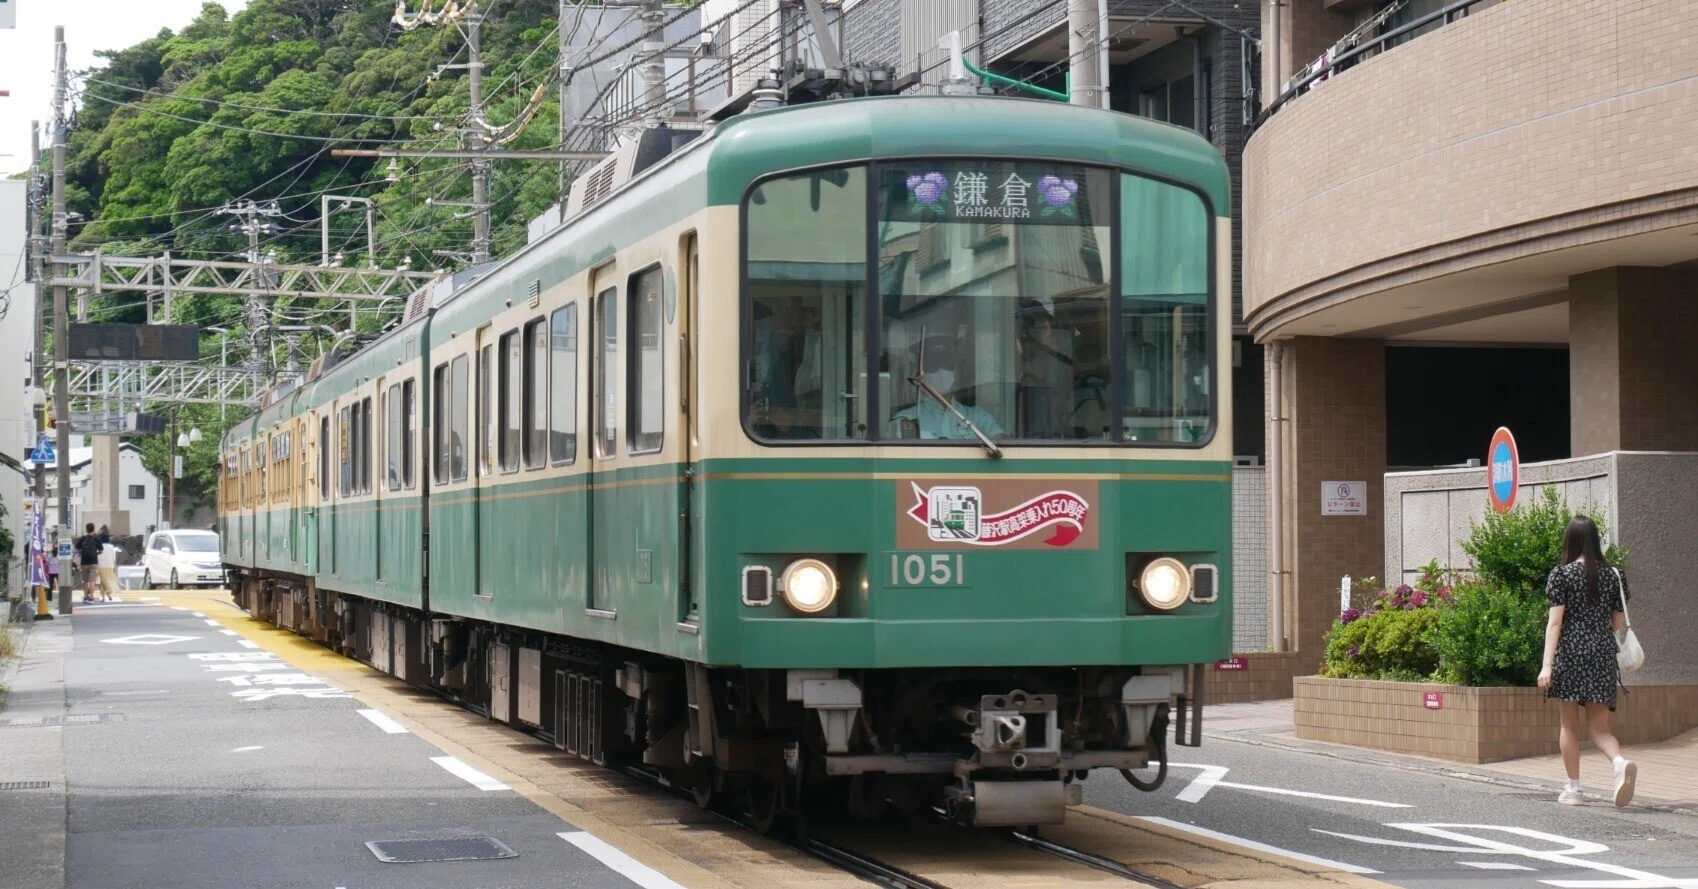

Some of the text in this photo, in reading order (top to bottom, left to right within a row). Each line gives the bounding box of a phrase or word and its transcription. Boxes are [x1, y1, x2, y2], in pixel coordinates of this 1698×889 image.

[953, 171, 1032, 206] 鎌倉
[956, 205, 1030, 219] KAMAKURA
[1327, 500, 1361, 508] Uターン禁止
[891, 554, 963, 585] 1051
